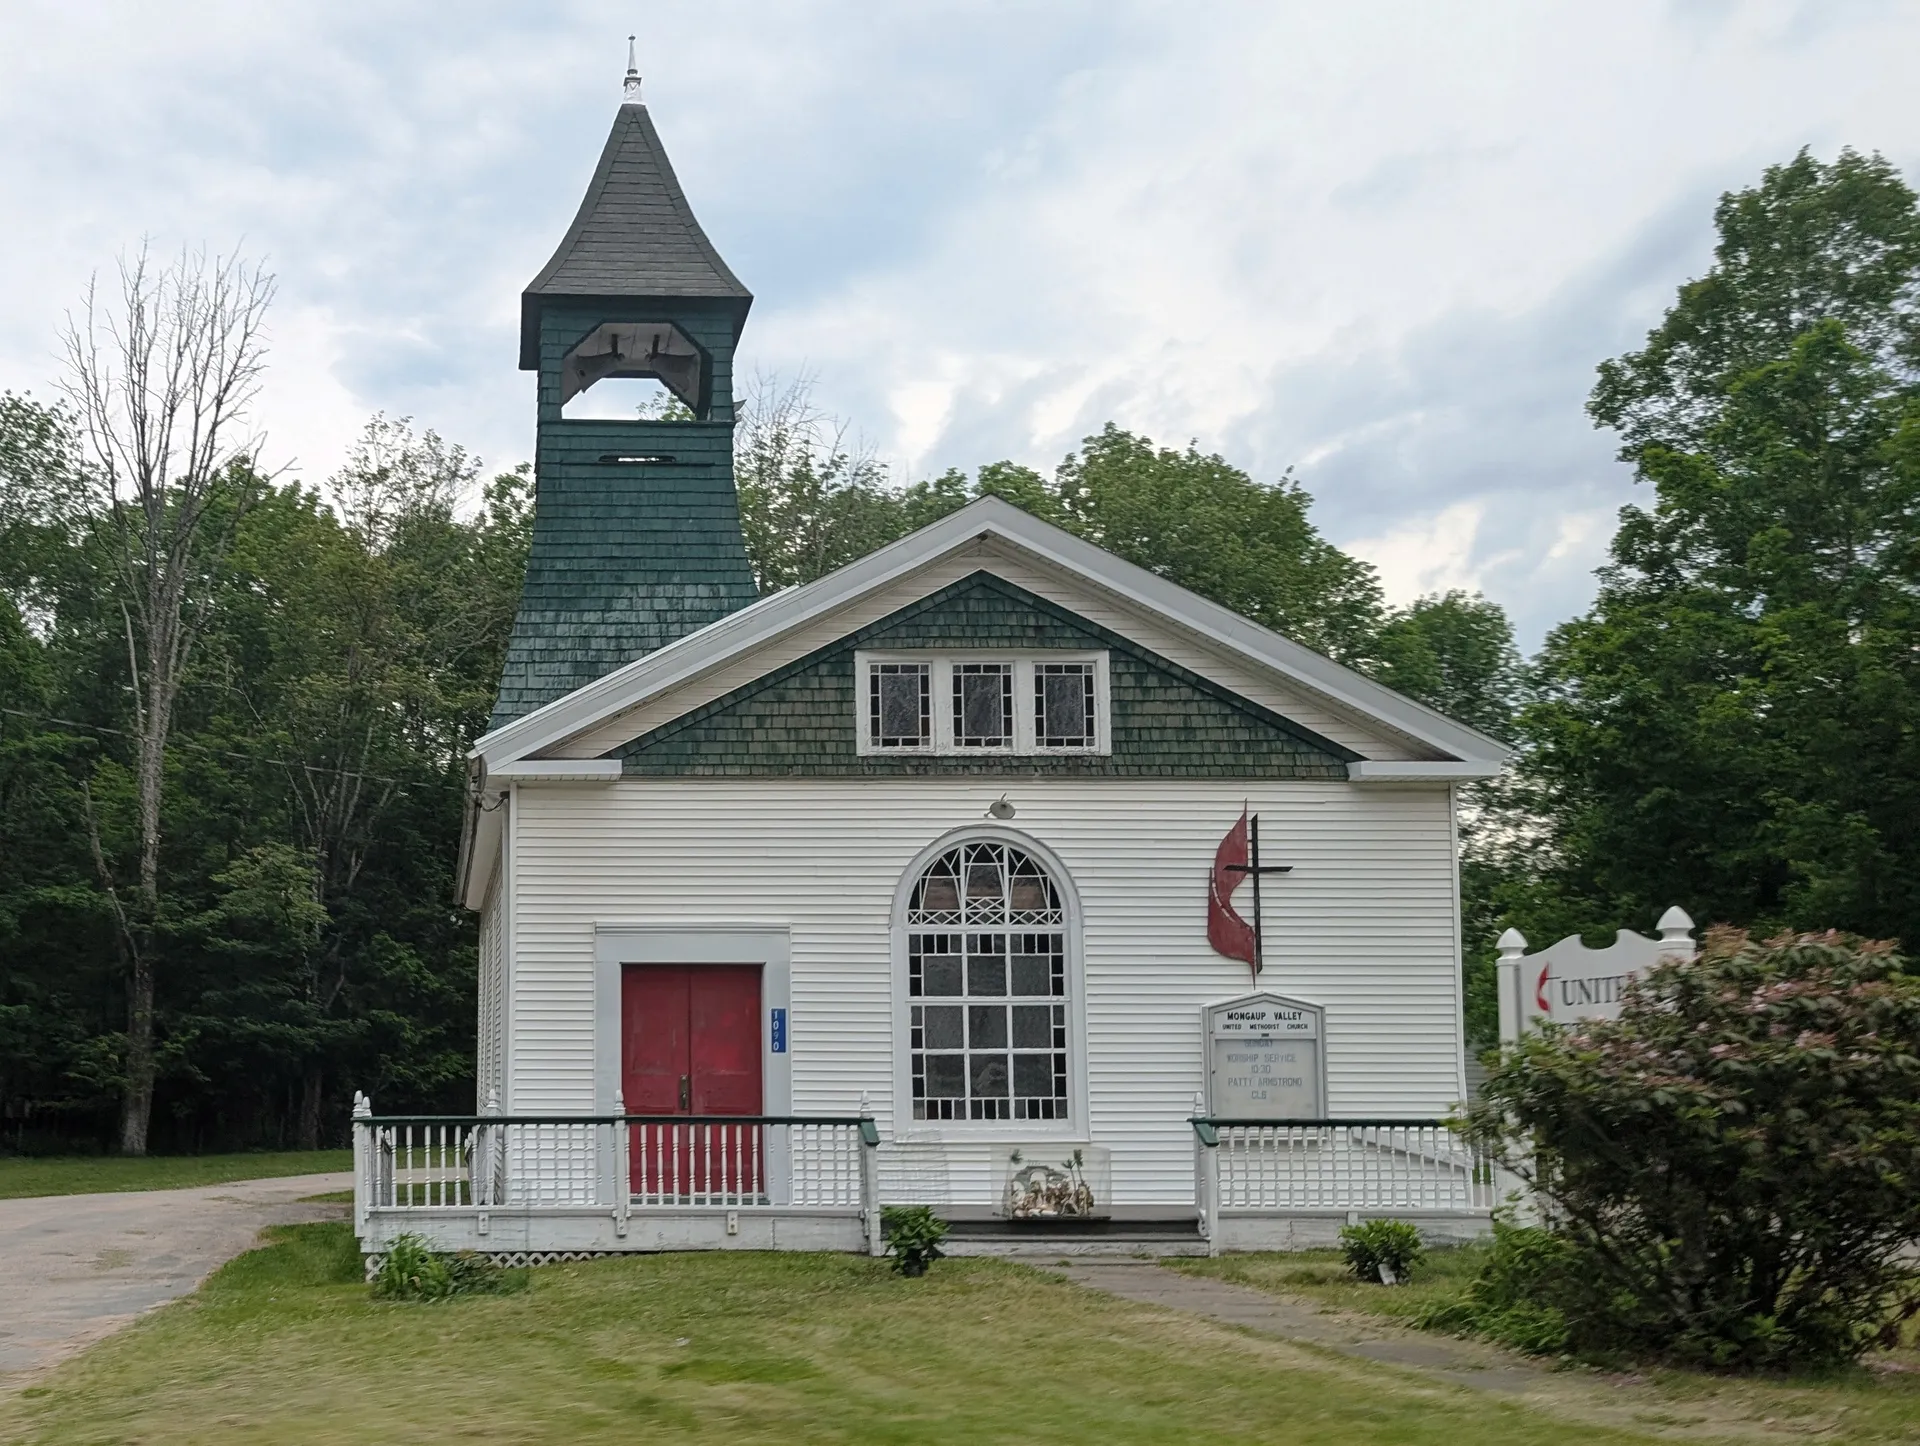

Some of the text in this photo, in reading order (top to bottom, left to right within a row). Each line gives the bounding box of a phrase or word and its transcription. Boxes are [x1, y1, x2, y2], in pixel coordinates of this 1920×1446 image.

[1560, 975, 1629, 1006] UNITE
[1227, 1012, 1303, 1021] MONGAUP VALLEY
[772, 1010, 780, 1051] 1090
[1227, 1054, 1297, 1063] WORSHIP SERVICE
[1228, 1077, 1252, 1087] PATTY
